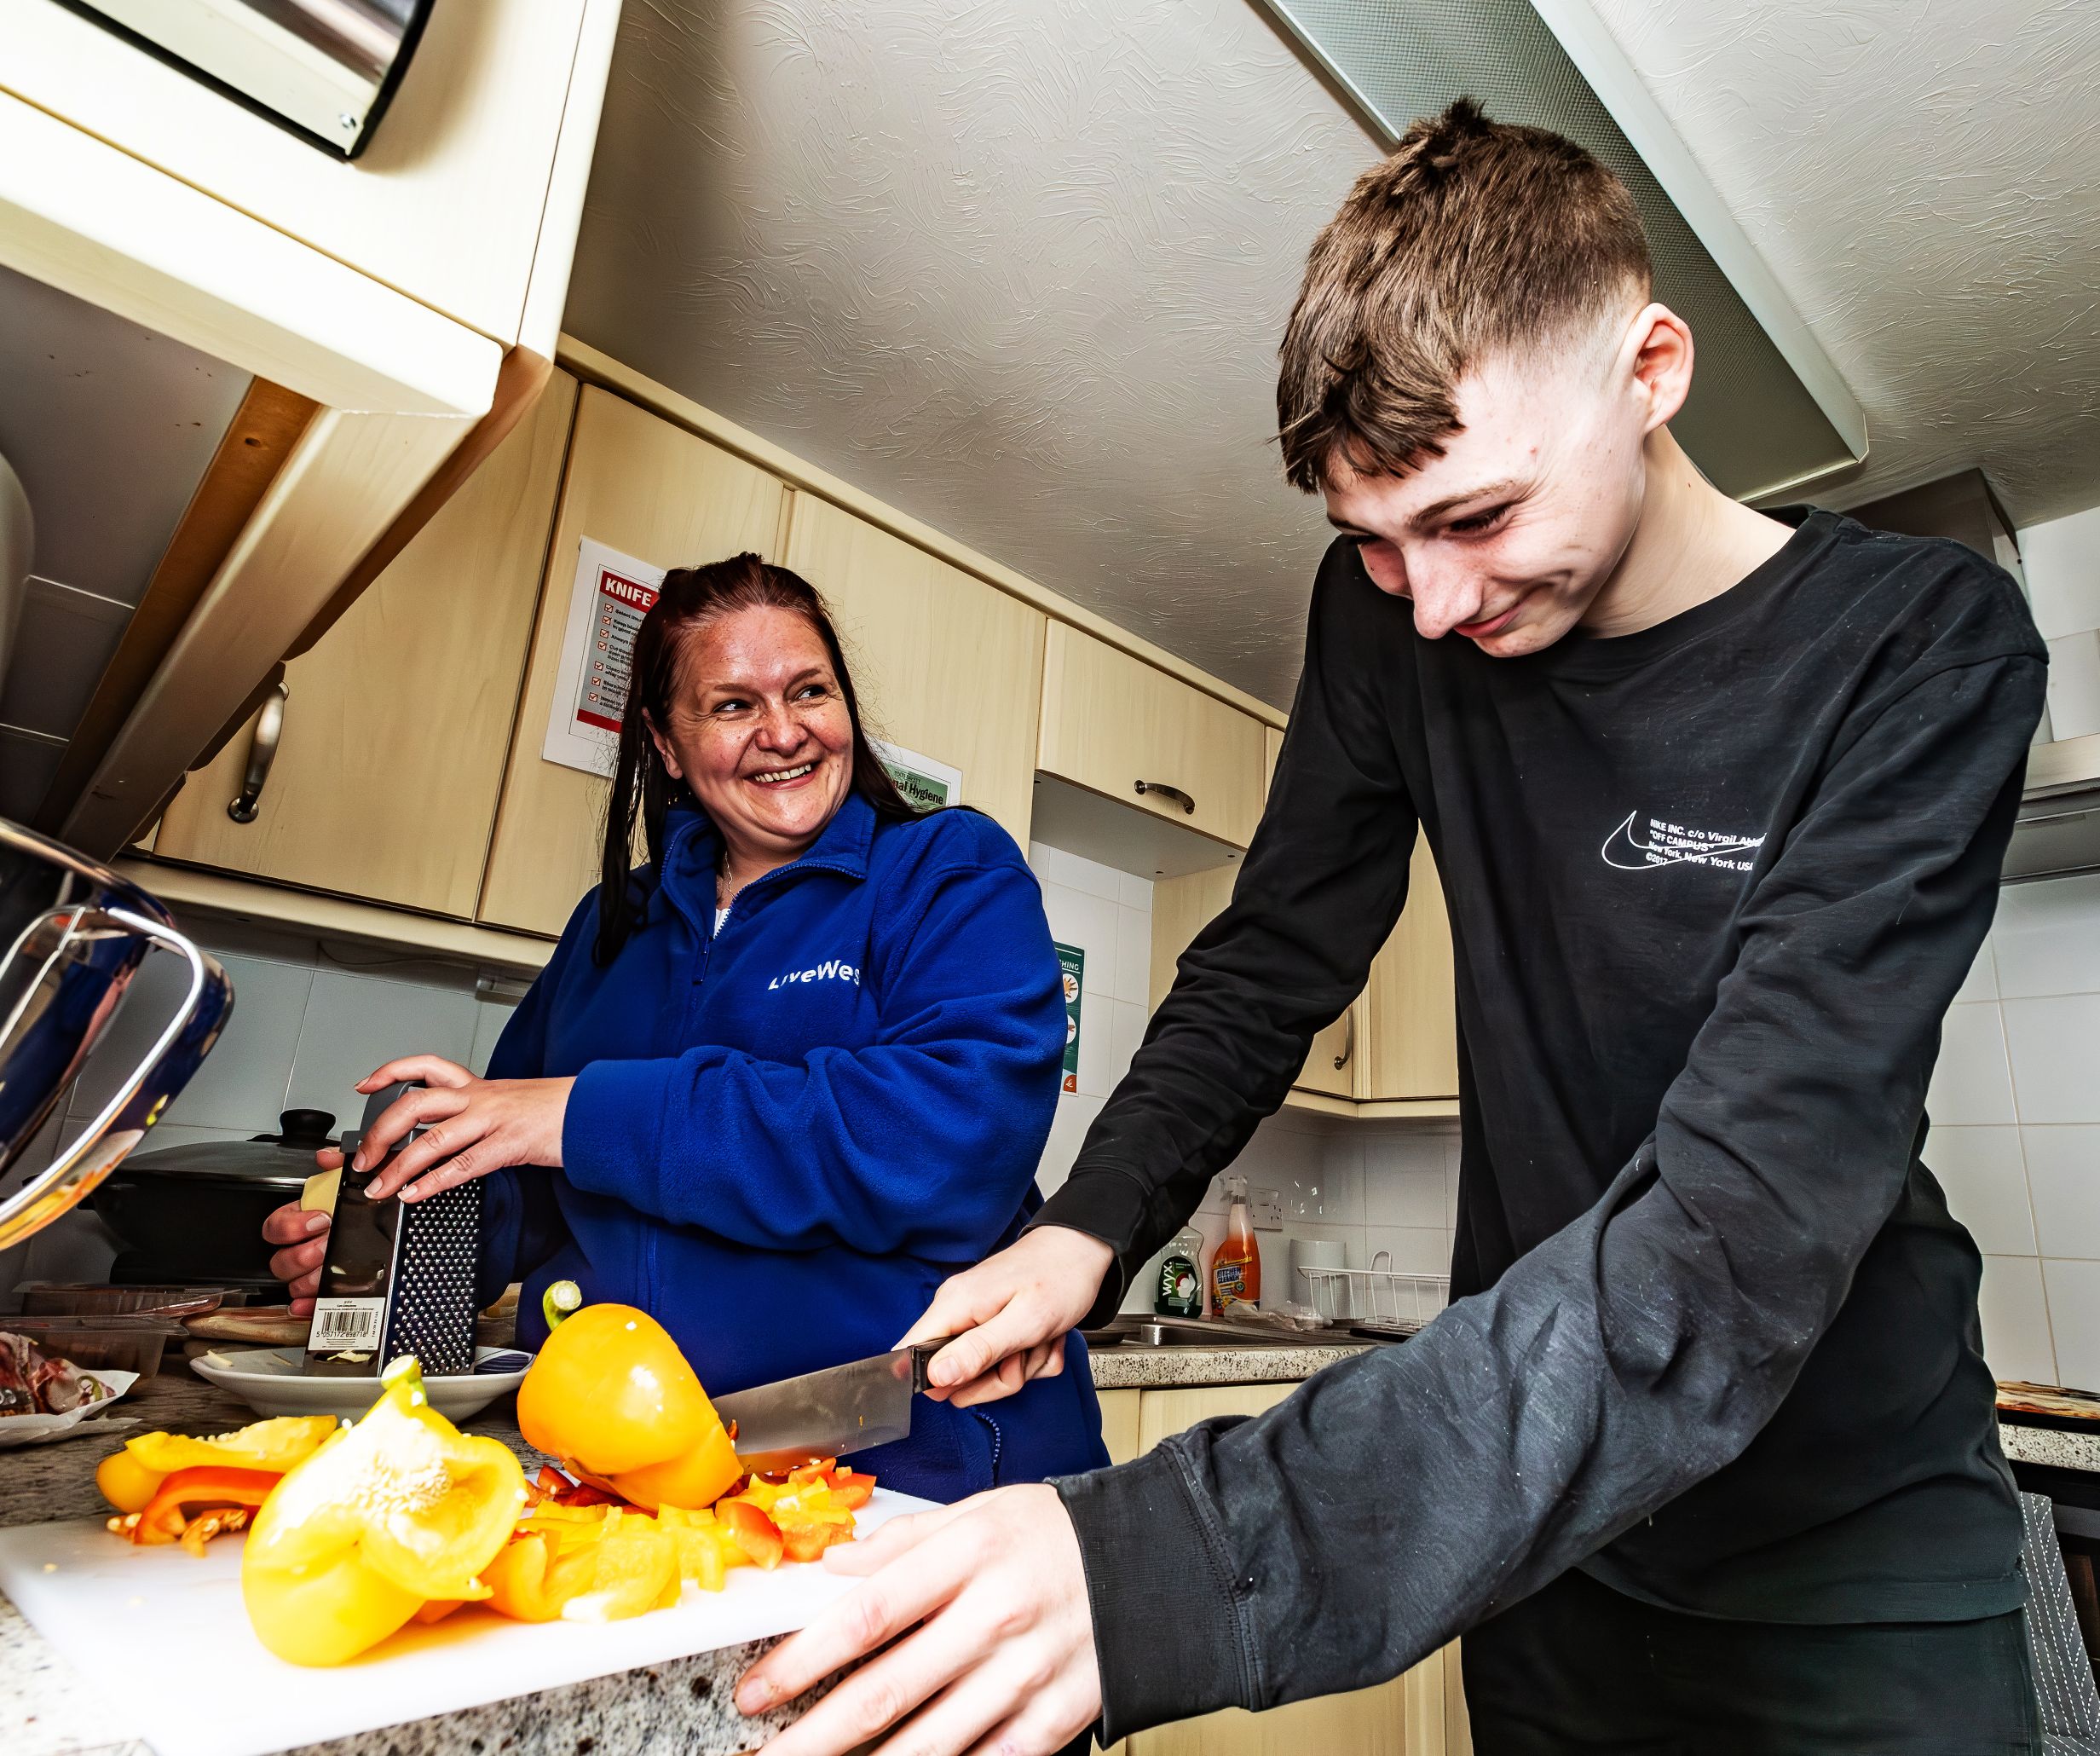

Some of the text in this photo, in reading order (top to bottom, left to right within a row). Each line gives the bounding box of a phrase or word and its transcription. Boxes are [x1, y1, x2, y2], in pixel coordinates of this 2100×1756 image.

[605, 577, 652, 607] KNIFE
[909, 782, 944, 806] Hygiene
[1649, 818, 1667, 832] NIKE
[1667, 823, 1686, 836] INC.
[1688, 829, 1705, 840] c/o
[1707, 831, 1738, 845] Virgil
[1684, 852, 1708, 864] New
[1710, 856, 1736, 869] York
[1059, 959, 1080, 971] HING
